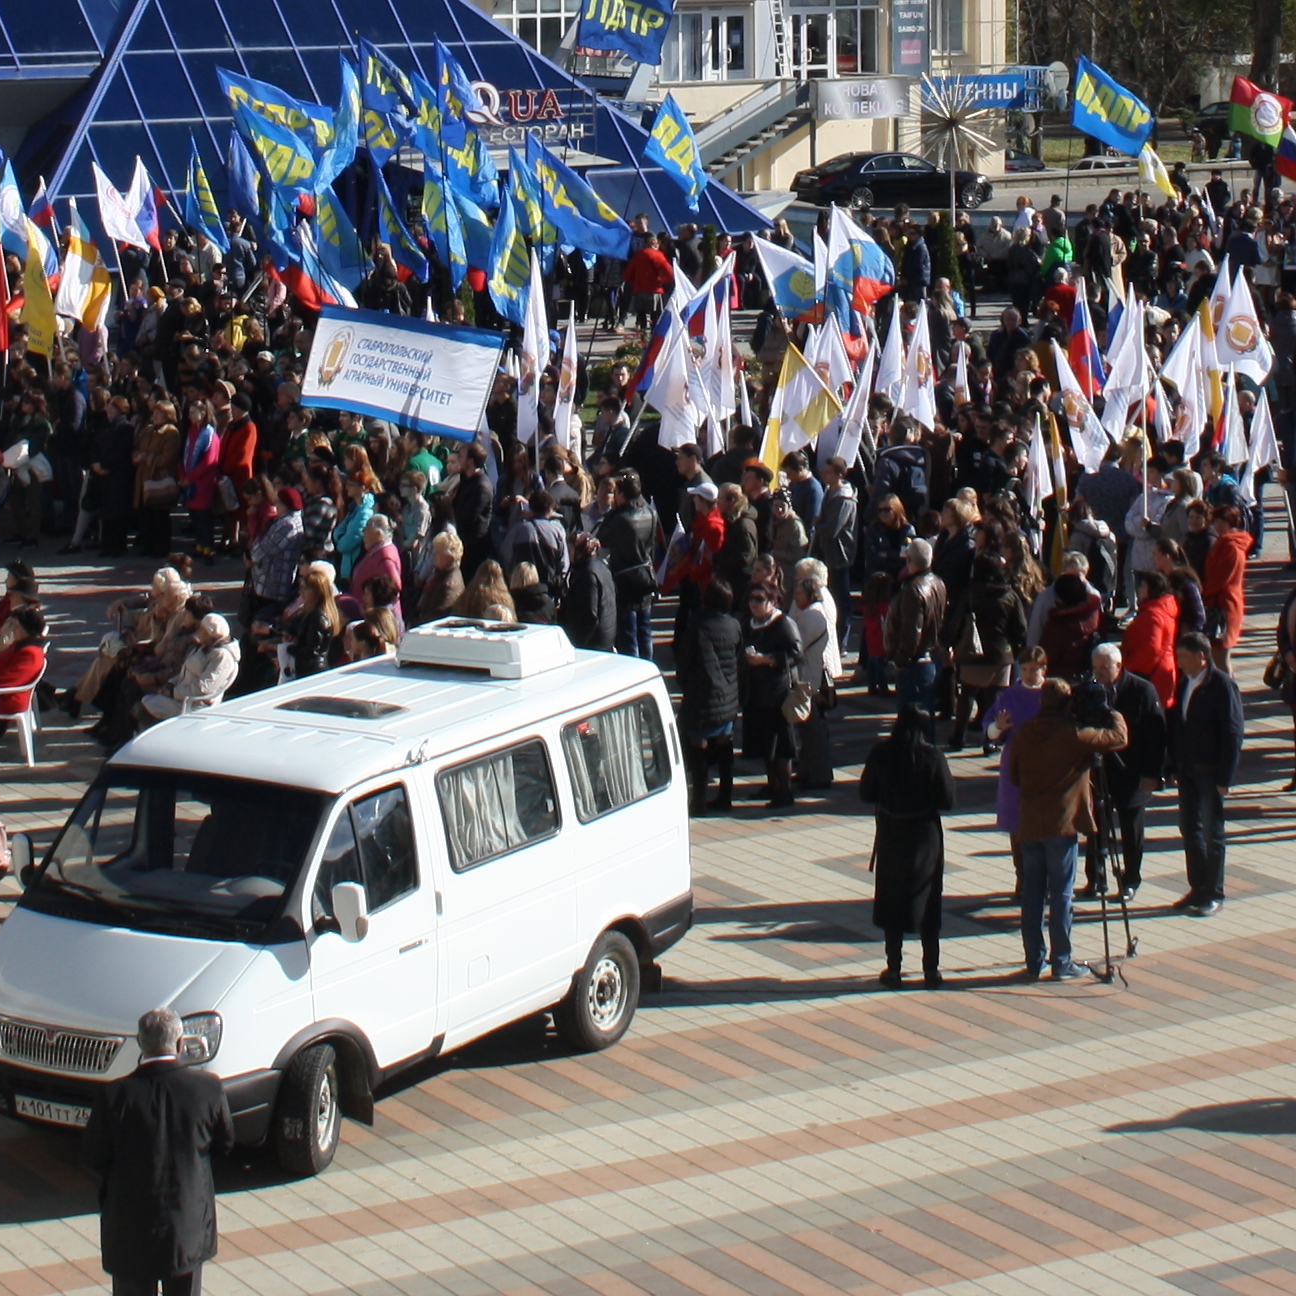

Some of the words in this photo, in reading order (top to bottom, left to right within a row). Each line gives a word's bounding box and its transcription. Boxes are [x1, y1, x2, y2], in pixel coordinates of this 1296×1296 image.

[1075, 72, 1151, 133] ЛДПР
[349, 353, 433, 383] ГОСУДАРСТВЕННЫЙ
[357, 338, 433, 365] СТАВРОПОЛЬСКИЙ
[342, 369, 387, 388] АГРАРНЫЙ
[384, 375, 454, 407] УНИВЕРСИТЕТ
